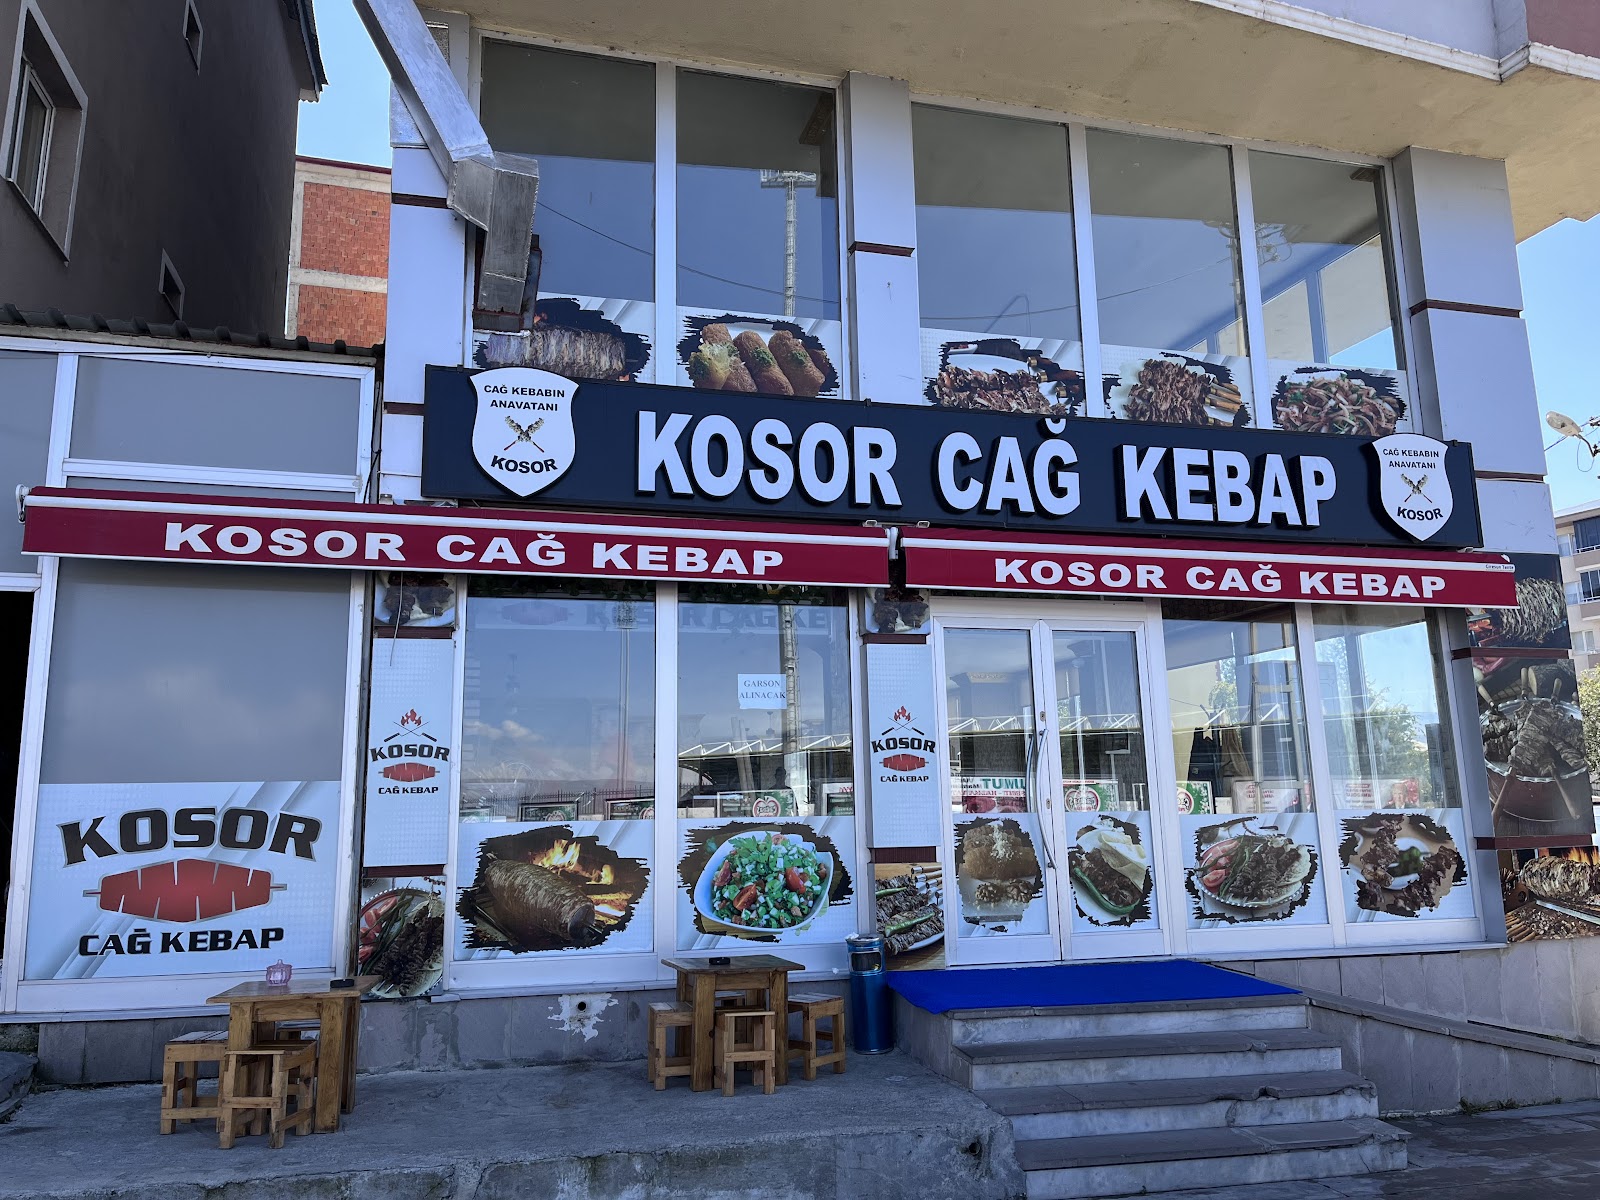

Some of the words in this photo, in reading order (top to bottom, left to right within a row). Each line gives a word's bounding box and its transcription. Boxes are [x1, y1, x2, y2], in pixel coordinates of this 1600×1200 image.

[484, 384, 508, 394] CAĞ
[511, 386, 565, 398] KEBABIN
[490, 399, 558, 411] ANAVATANI
[1382, 447, 1399, 456] CAĞ
[1401, 449, 1440, 458] KEBABIN
[490, 454, 558, 474] KOSOR
[636, 409, 902, 507] KOSOR
[937, 417, 1081, 516] CAĞ
[1121, 443, 1338, 527] KEBAP
[1389, 460, 1436, 469] ANAVATANI
[1396, 506, 1443, 521] KOSOR
[164, 521, 406, 563] KOSOR
[436, 533, 567, 568] CAĞ
[591, 542, 784, 576] KEBAP
[994, 557, 1168, 589] KOSOR
[1185, 563, 1283, 593] CAĞ
[1299, 571, 1448, 599] KEBAP
[743, 680, 781, 688] GARSON
[739, 691, 786, 699] ALINACAK
[369, 743, 450, 763] KOSOR
[870, 737, 936, 754] KOSOR
[880, 774, 899, 783] CAĞ
[899, 775, 930, 783] KEBAP
[378, 785, 401, 795] CAĞ
[402, 786, 439, 794] KEBAP
[56, 806, 323, 868] KOSOR
[78, 928, 152, 957] CAĞ
[159, 927, 285, 955] KEBAP
